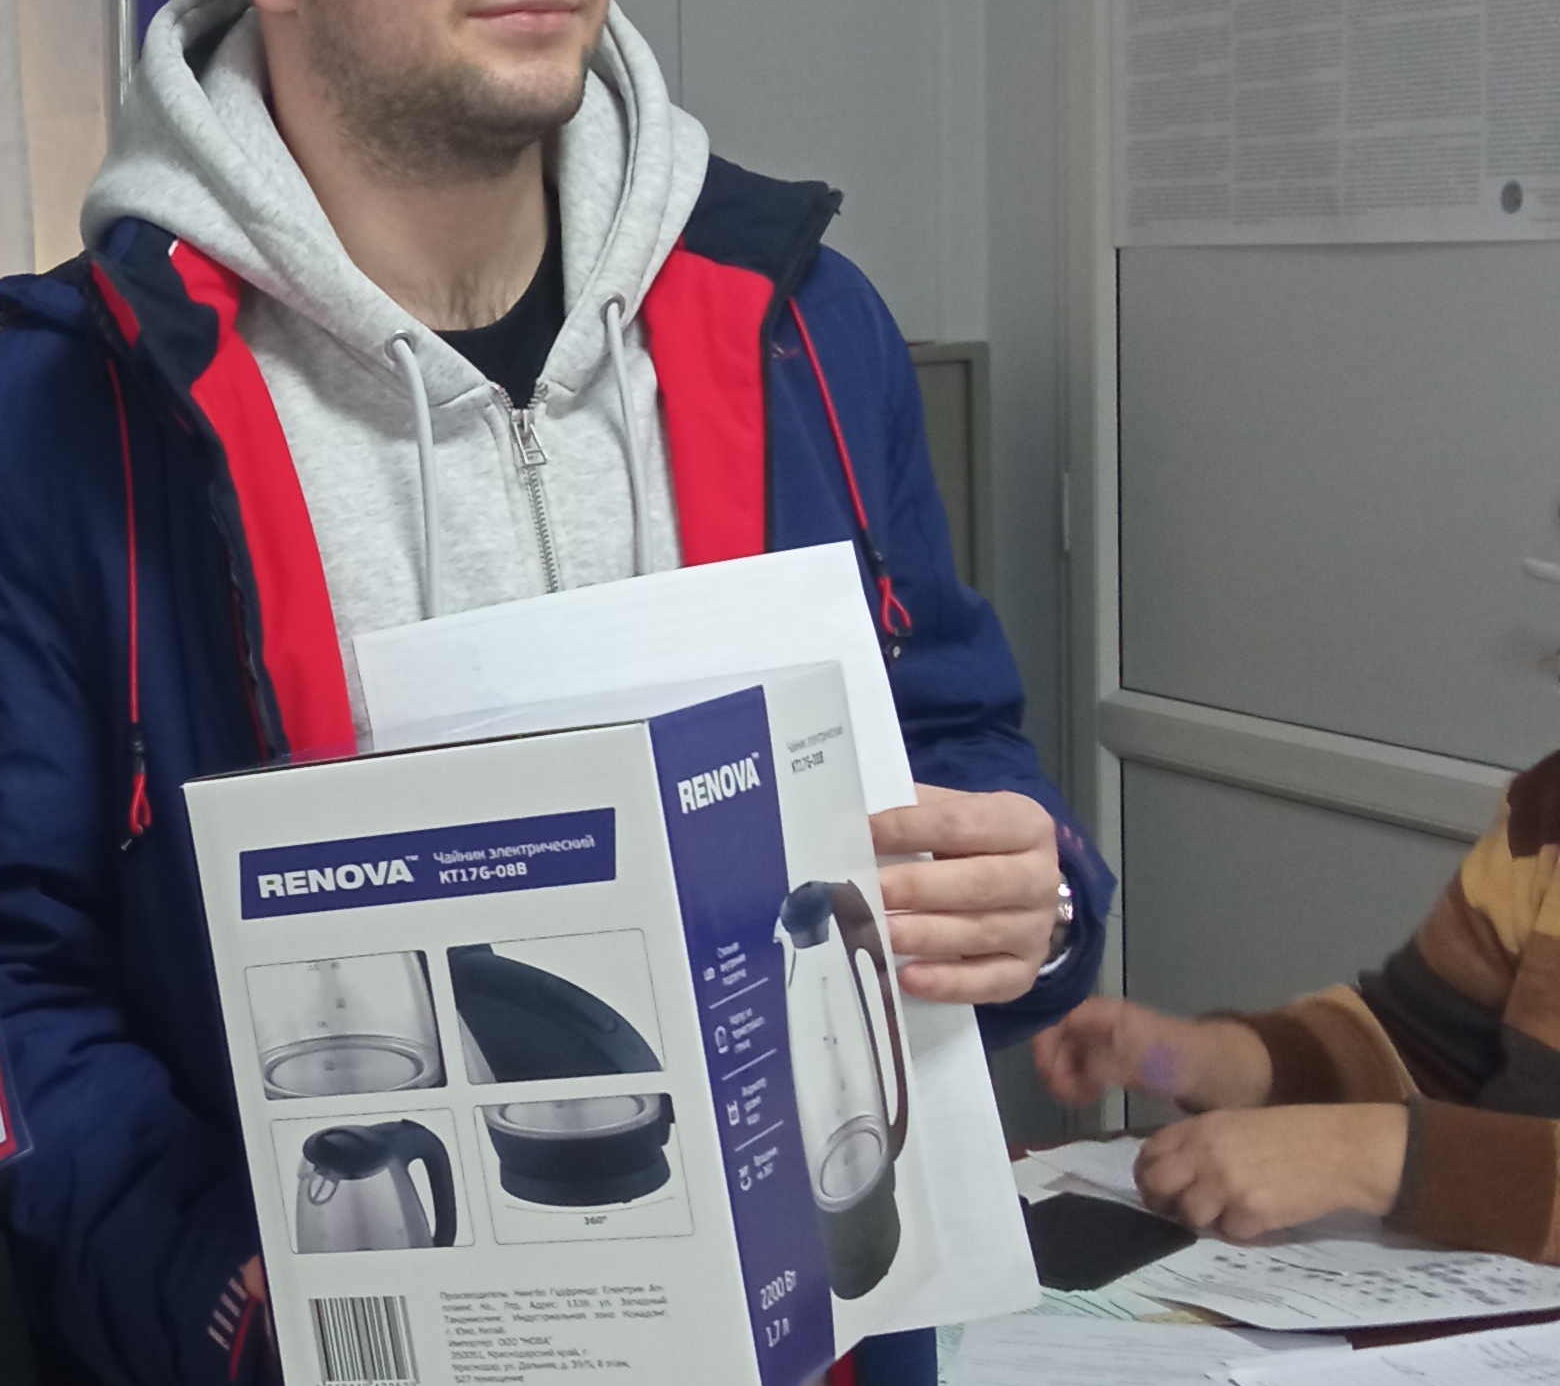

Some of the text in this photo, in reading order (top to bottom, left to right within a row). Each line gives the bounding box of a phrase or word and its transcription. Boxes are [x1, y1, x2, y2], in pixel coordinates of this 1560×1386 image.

[677, 757, 761, 814] RENOVA
[433, 834, 596, 865] Чайник электрический
[258, 858, 415, 899] RENOVA
[439, 862, 528, 885] KT17G-08B
[760, 1276, 785, 1310] 2200
